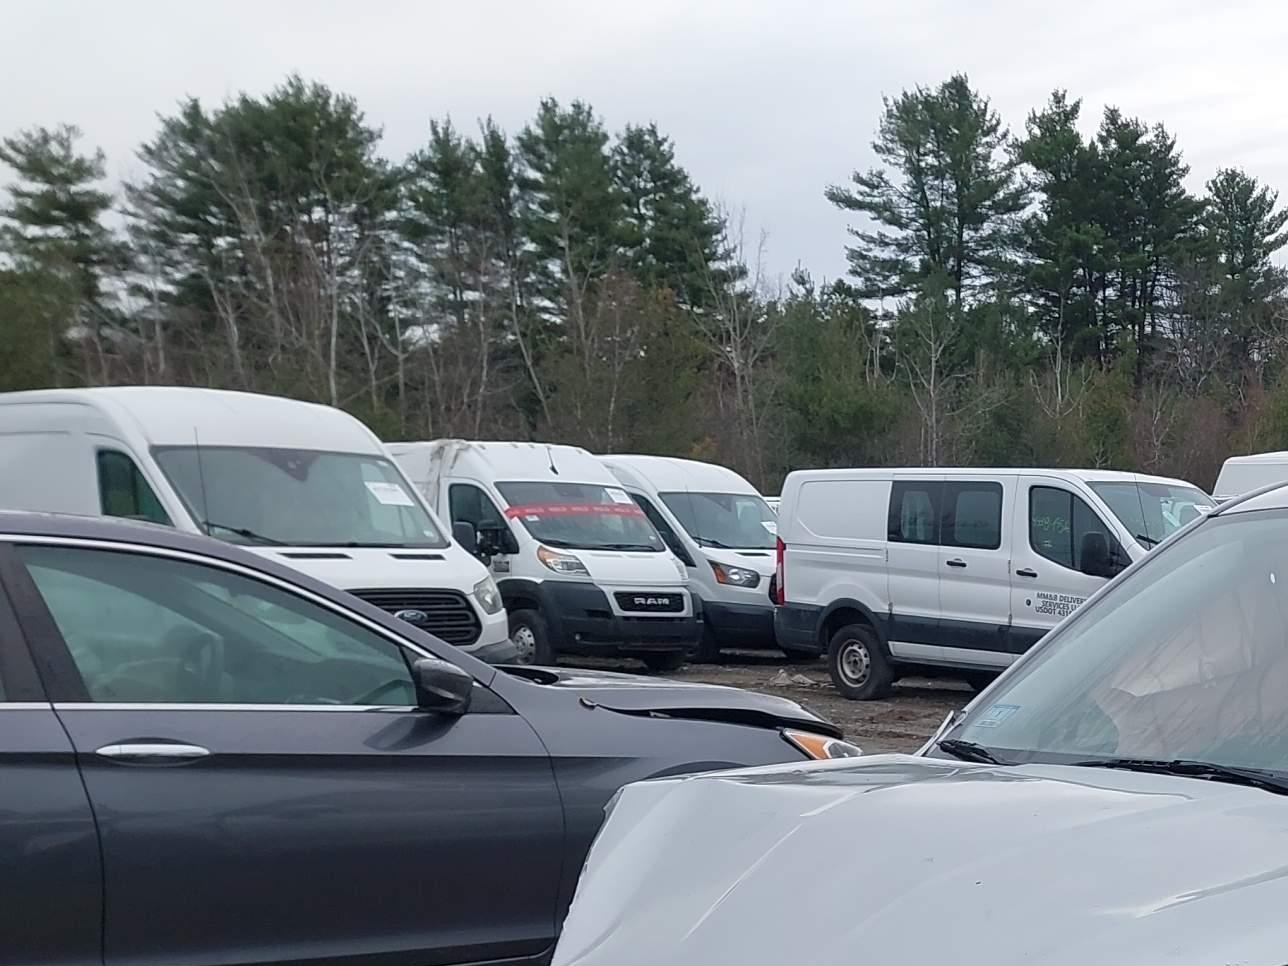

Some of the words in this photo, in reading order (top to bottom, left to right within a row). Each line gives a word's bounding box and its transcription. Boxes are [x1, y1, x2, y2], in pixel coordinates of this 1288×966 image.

[634, 597, 669, 605] RAM
[1041, 600, 1069, 610] SERVICES
[1035, 606, 1056, 615] USDOT
